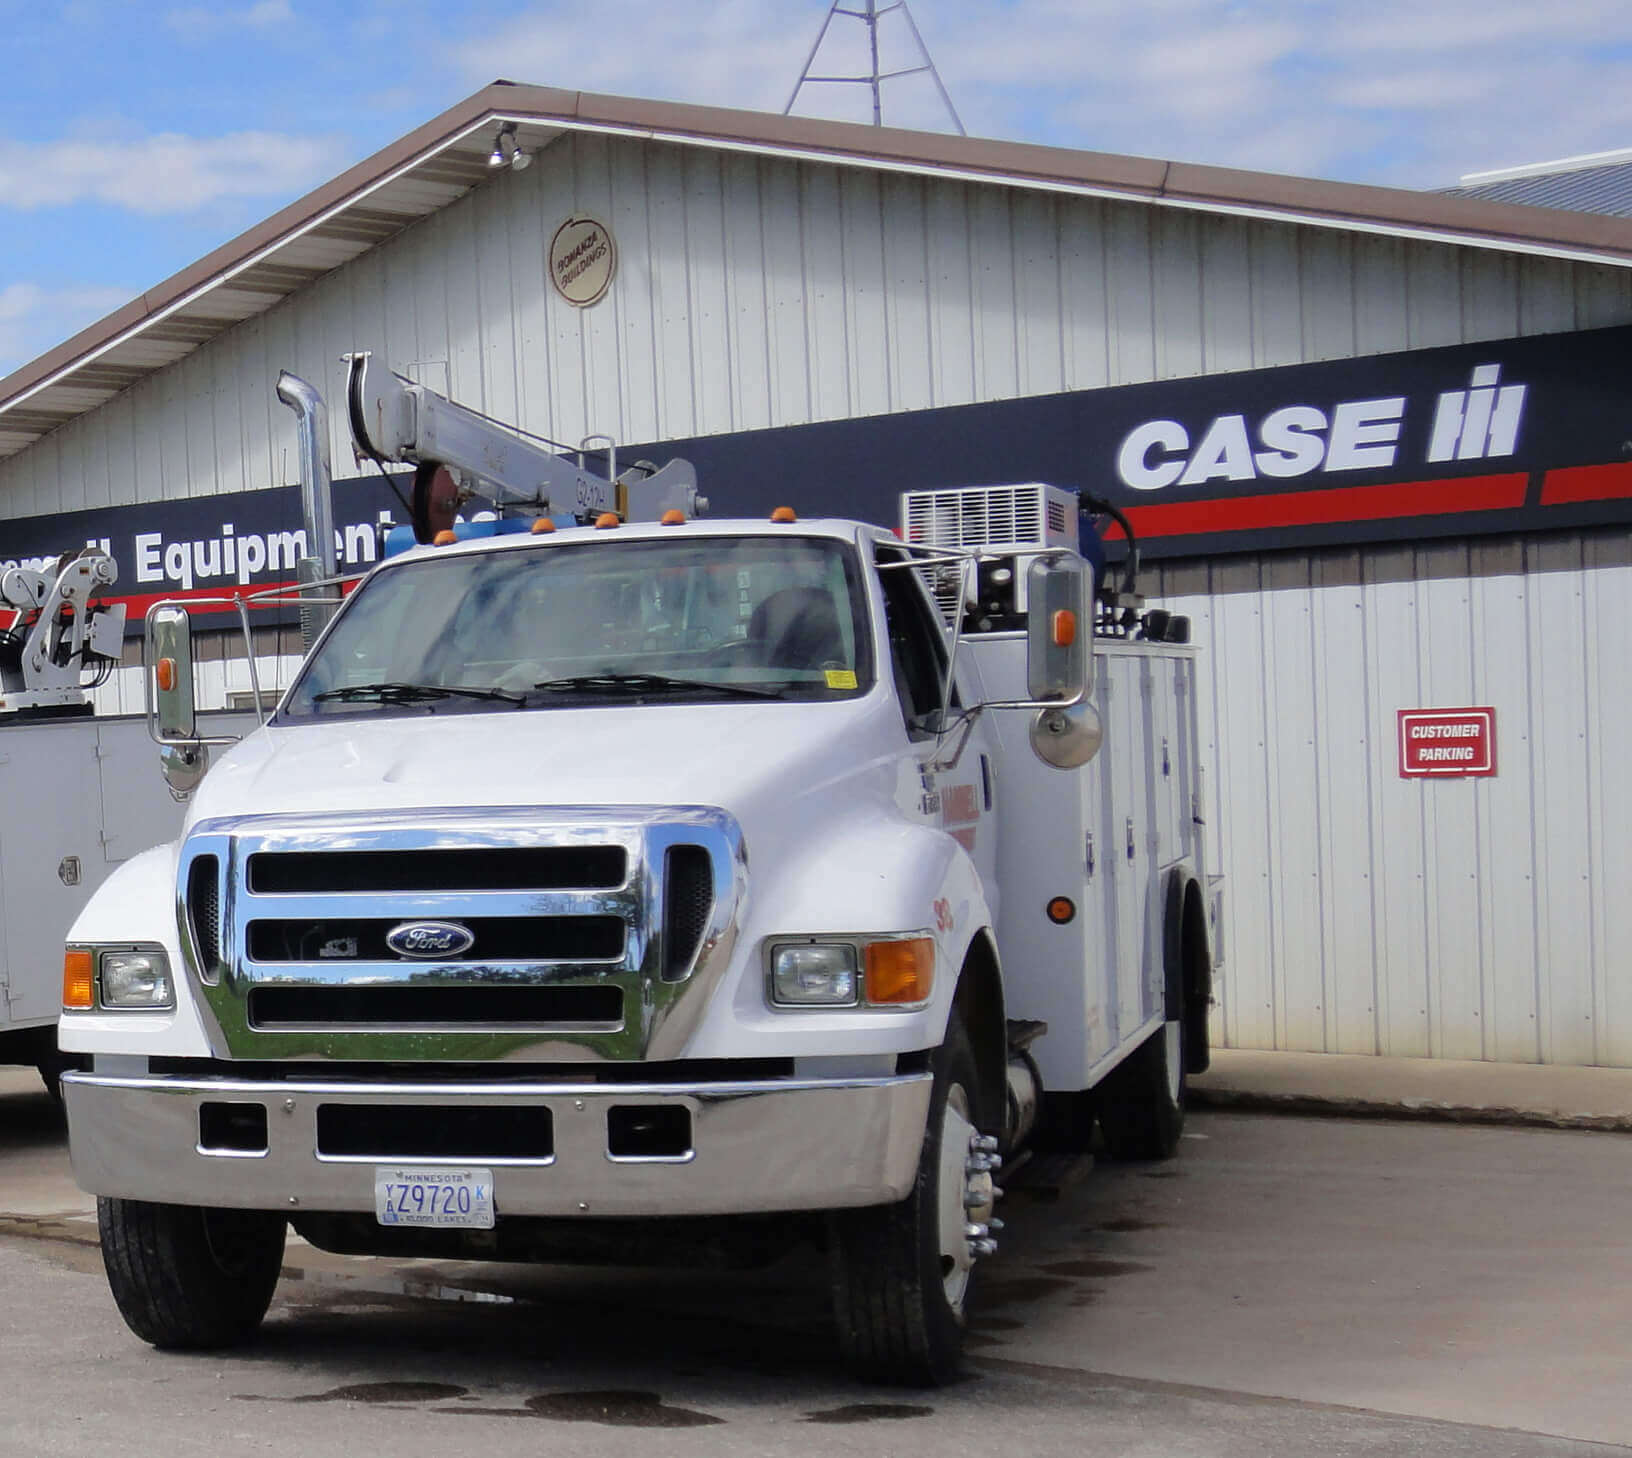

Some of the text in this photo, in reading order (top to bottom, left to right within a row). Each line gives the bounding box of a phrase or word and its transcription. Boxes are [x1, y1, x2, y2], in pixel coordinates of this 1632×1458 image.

[561, 241, 607, 289] BUILDINGS
[1116, 395, 1407, 491] CASE
[136, 510, 392, 590] Equipmn
[1411, 724, 1480, 739] CUSTOMER
[1419, 747, 1474, 761] PARKING
[405, 928, 453, 950] Ford
[405, 1174, 464, 1183] MINNESOTA
[396, 1184, 471, 1214] Z9720
[437, 1215, 467, 1224] LAKES
